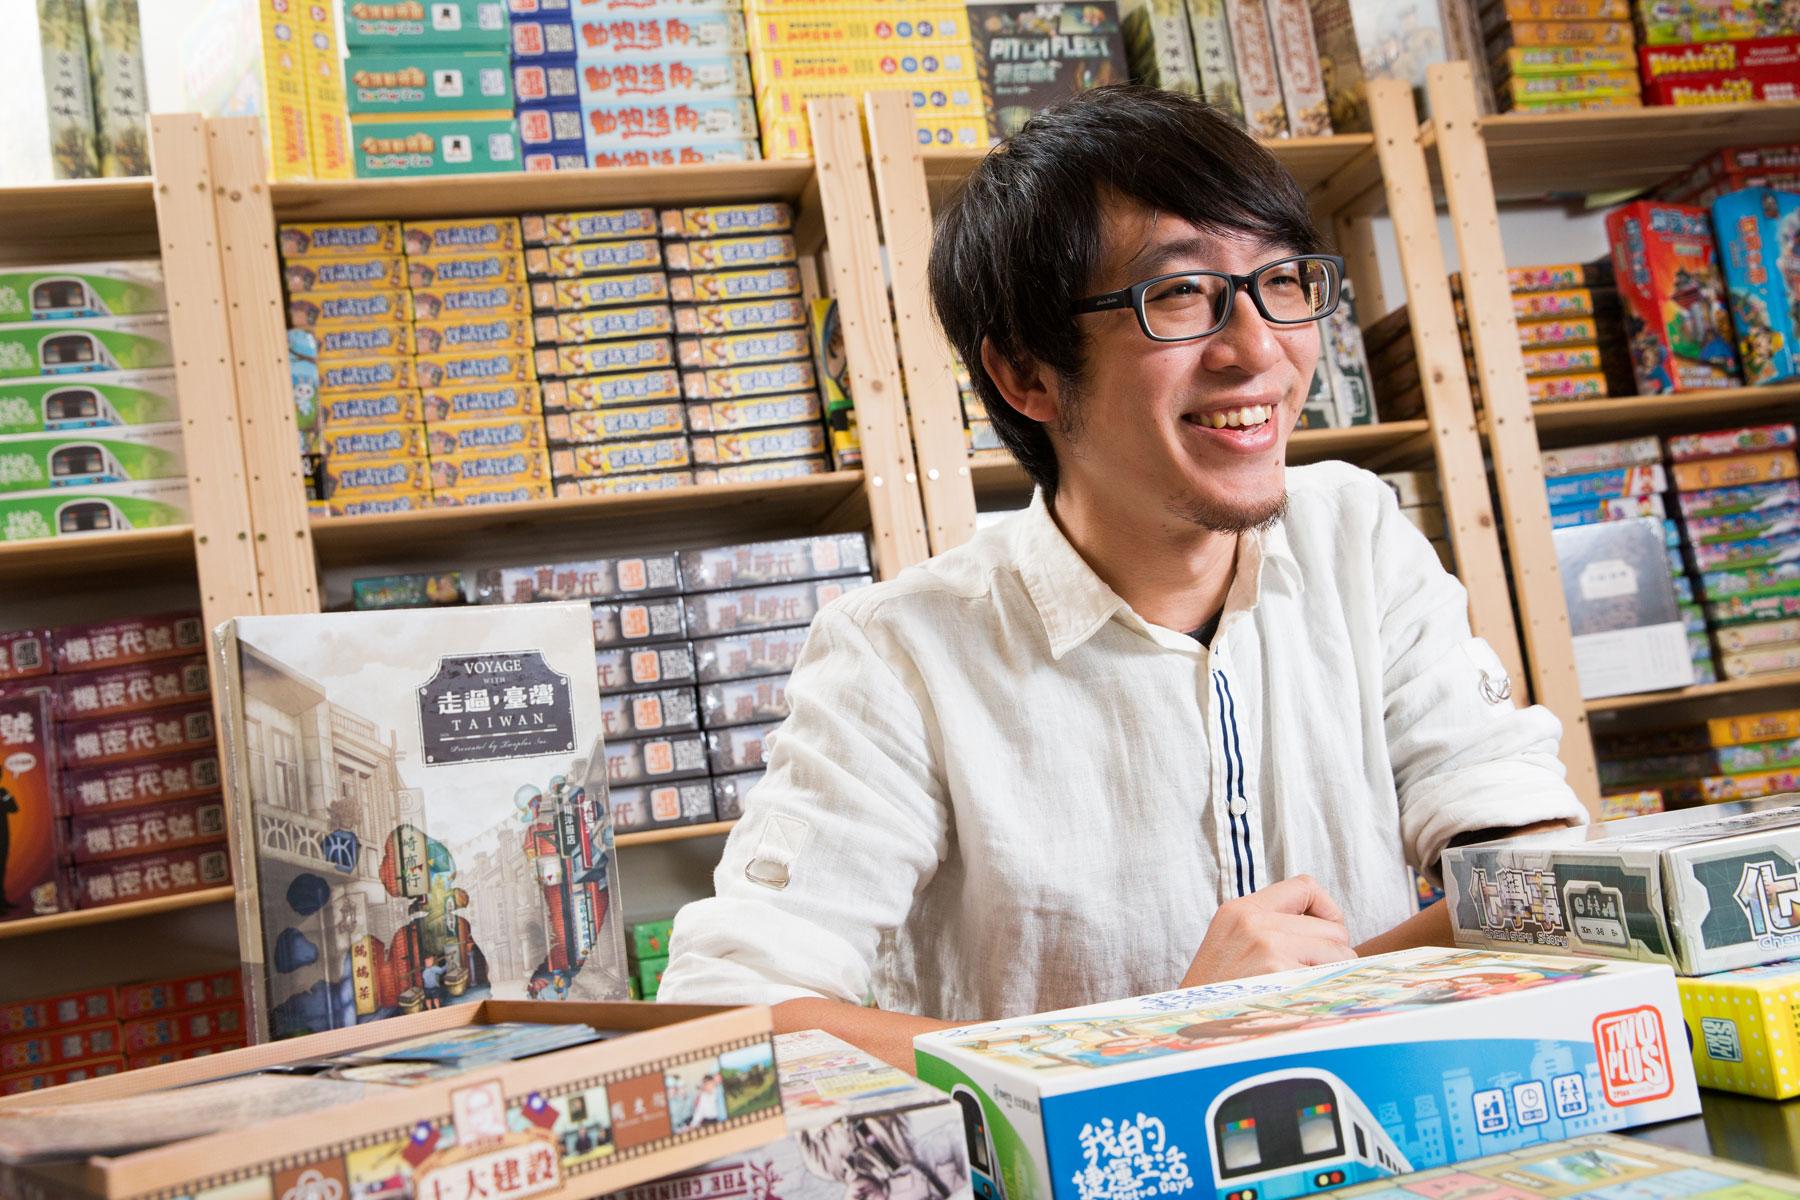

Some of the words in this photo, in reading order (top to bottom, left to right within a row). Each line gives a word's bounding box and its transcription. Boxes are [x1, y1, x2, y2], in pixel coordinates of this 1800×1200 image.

[65, 626, 173, 665] 機密代號
[464, 659, 523, 675] VOYAGE
[483, 677, 506, 685] WITH
[71, 677, 181, 712] 機密代號
[74, 721, 184, 760] 機密代號
[451, 713, 544, 732] TAIWAN
[78, 767, 190, 806] 機密代號
[85, 815, 196, 854] 機密代號
[87, 861, 198, 901] 機密代號
[1483, 927, 1534, 944] Chemistry
[1537, 932, 1569, 949] Story
[1606, 1010, 1656, 1050] TWO
[1608, 1043, 1665, 1086] PLUS
[1078, 1112, 1167, 1165] 我的
[712, 1171, 747, 1190] THE
[1072, 1145, 1190, 1200] 捷運生活
[1159, 1176, 1195, 1196] Days
